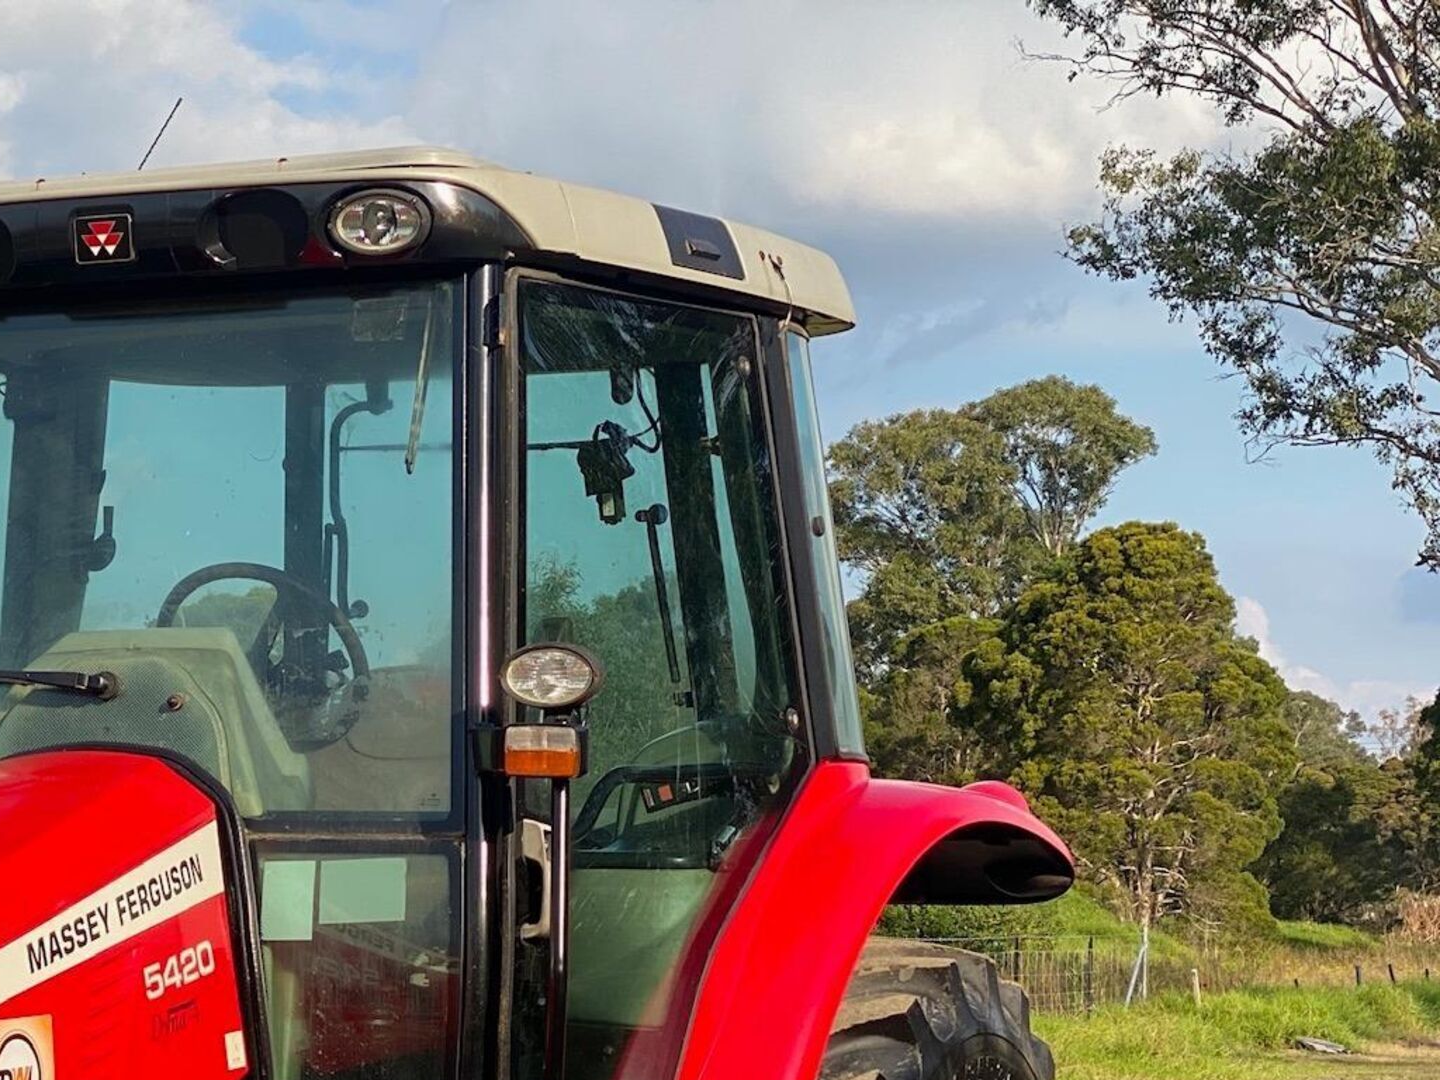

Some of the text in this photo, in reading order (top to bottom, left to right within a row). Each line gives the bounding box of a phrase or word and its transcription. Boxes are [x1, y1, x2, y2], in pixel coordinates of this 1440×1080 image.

[26, 853, 204, 974] MASSEY FERGUSON
[143, 939, 216, 1001] 5420
